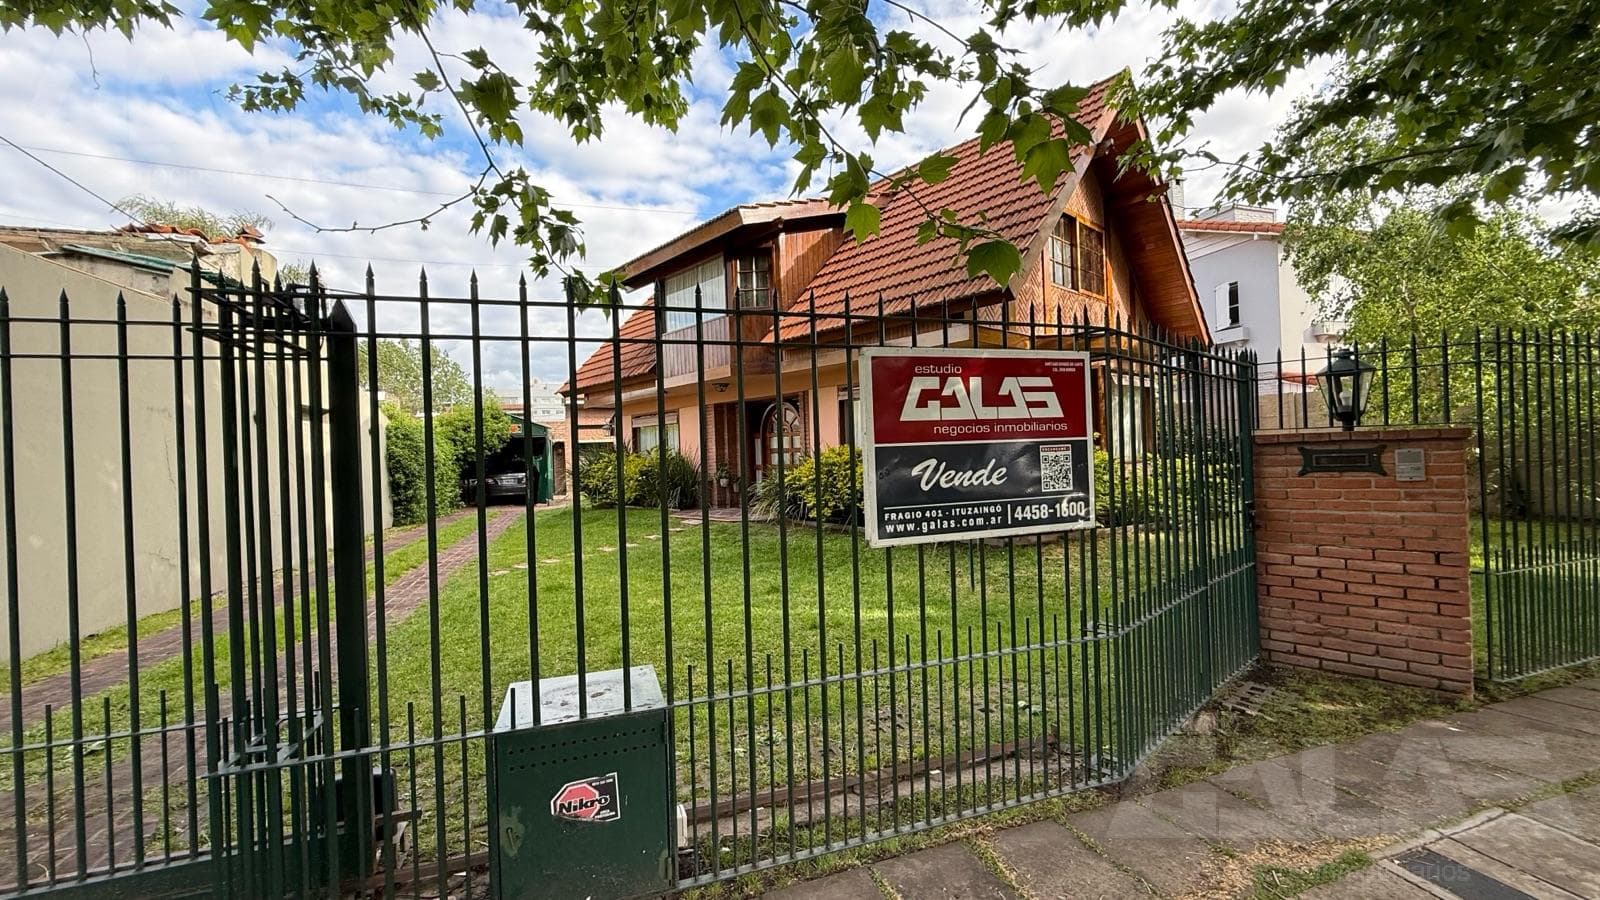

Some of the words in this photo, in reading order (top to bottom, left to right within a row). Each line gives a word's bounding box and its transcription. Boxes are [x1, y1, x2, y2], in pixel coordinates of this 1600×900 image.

[914, 364, 962, 374] estudio
[899, 376, 1065, 422] GALAS
[933, 423, 991, 437] negocios
[993, 421, 1068, 433] inmobiliarios
[911, 458, 1008, 492] Vende
[884, 511, 922, 521] FRAGIO
[924, 510, 943, 518] 401
[885, 515, 1003, 533] www.galas.com.ar
